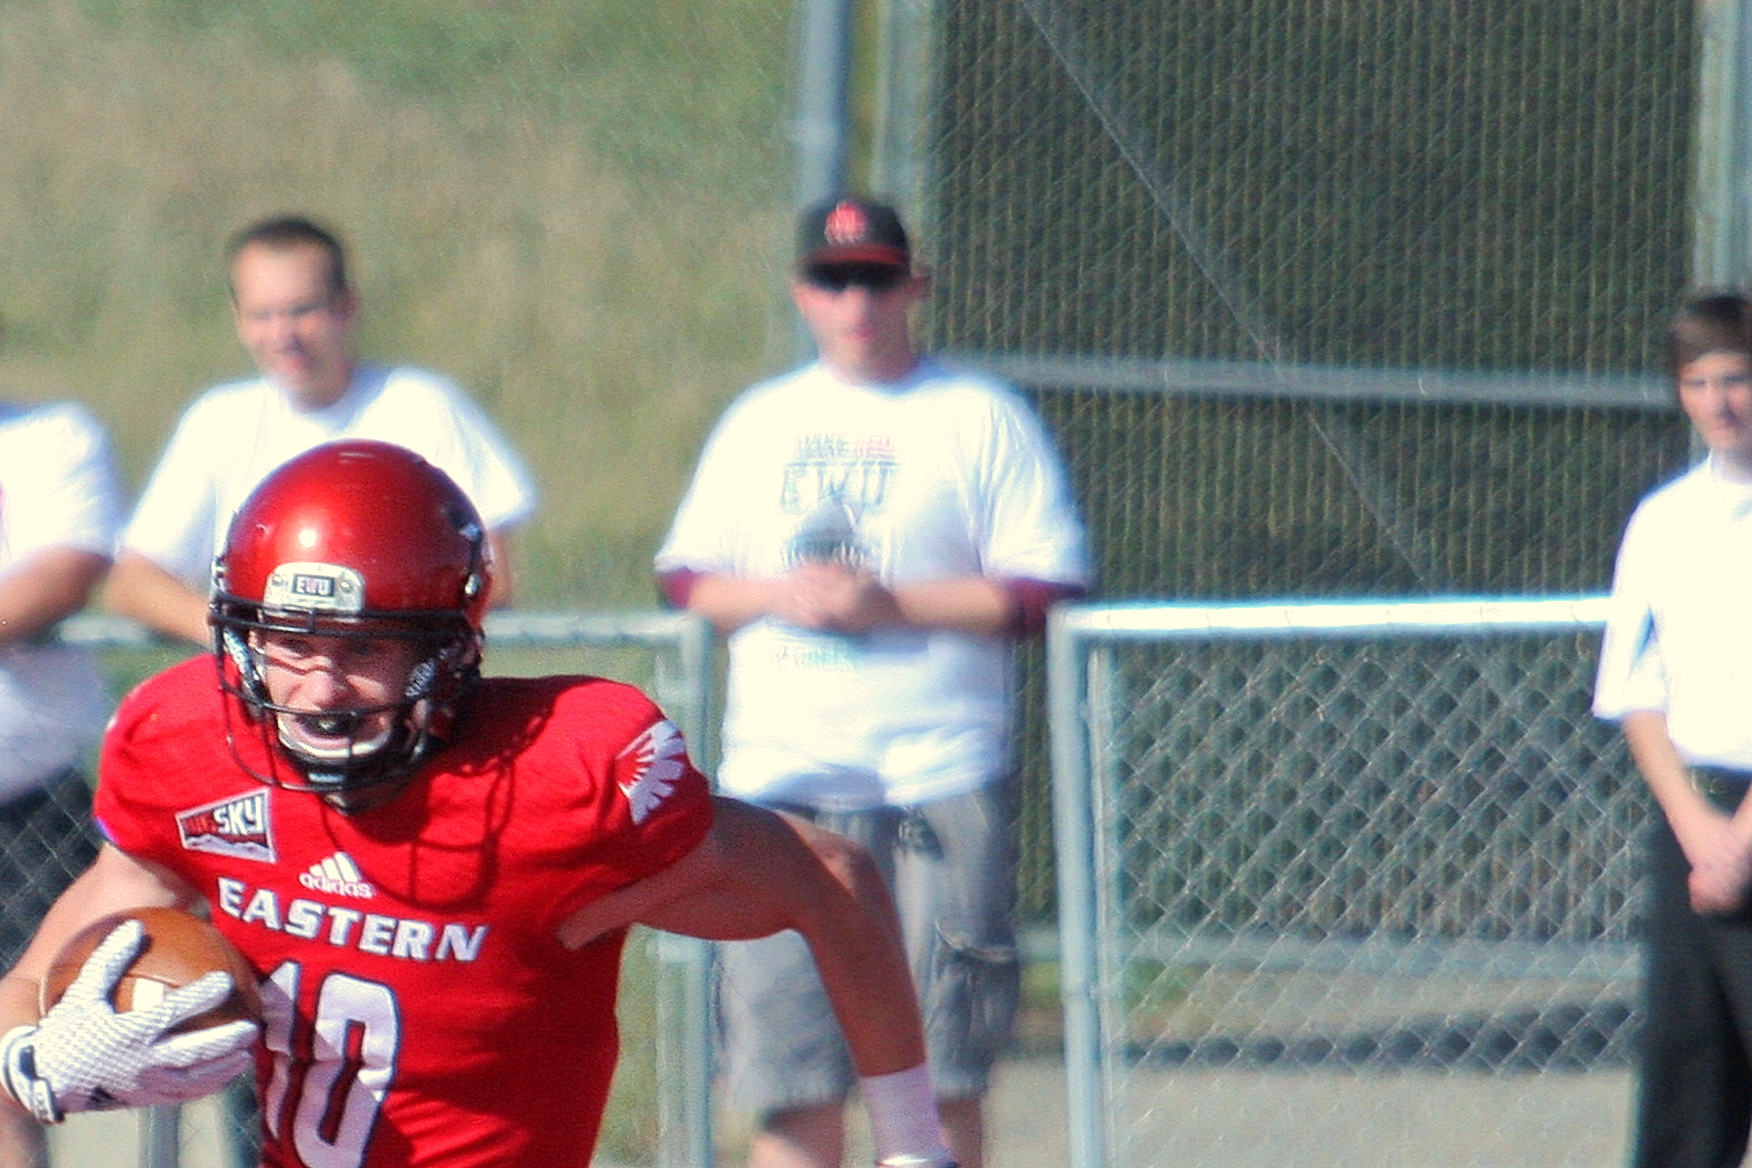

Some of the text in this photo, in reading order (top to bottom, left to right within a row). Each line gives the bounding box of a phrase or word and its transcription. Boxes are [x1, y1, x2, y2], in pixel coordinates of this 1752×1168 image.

[296, 575, 333, 597] EWU
[213, 795, 264, 836] SKY
[298, 871, 375, 899] adidas
[217, 876, 490, 963] EASTERN
